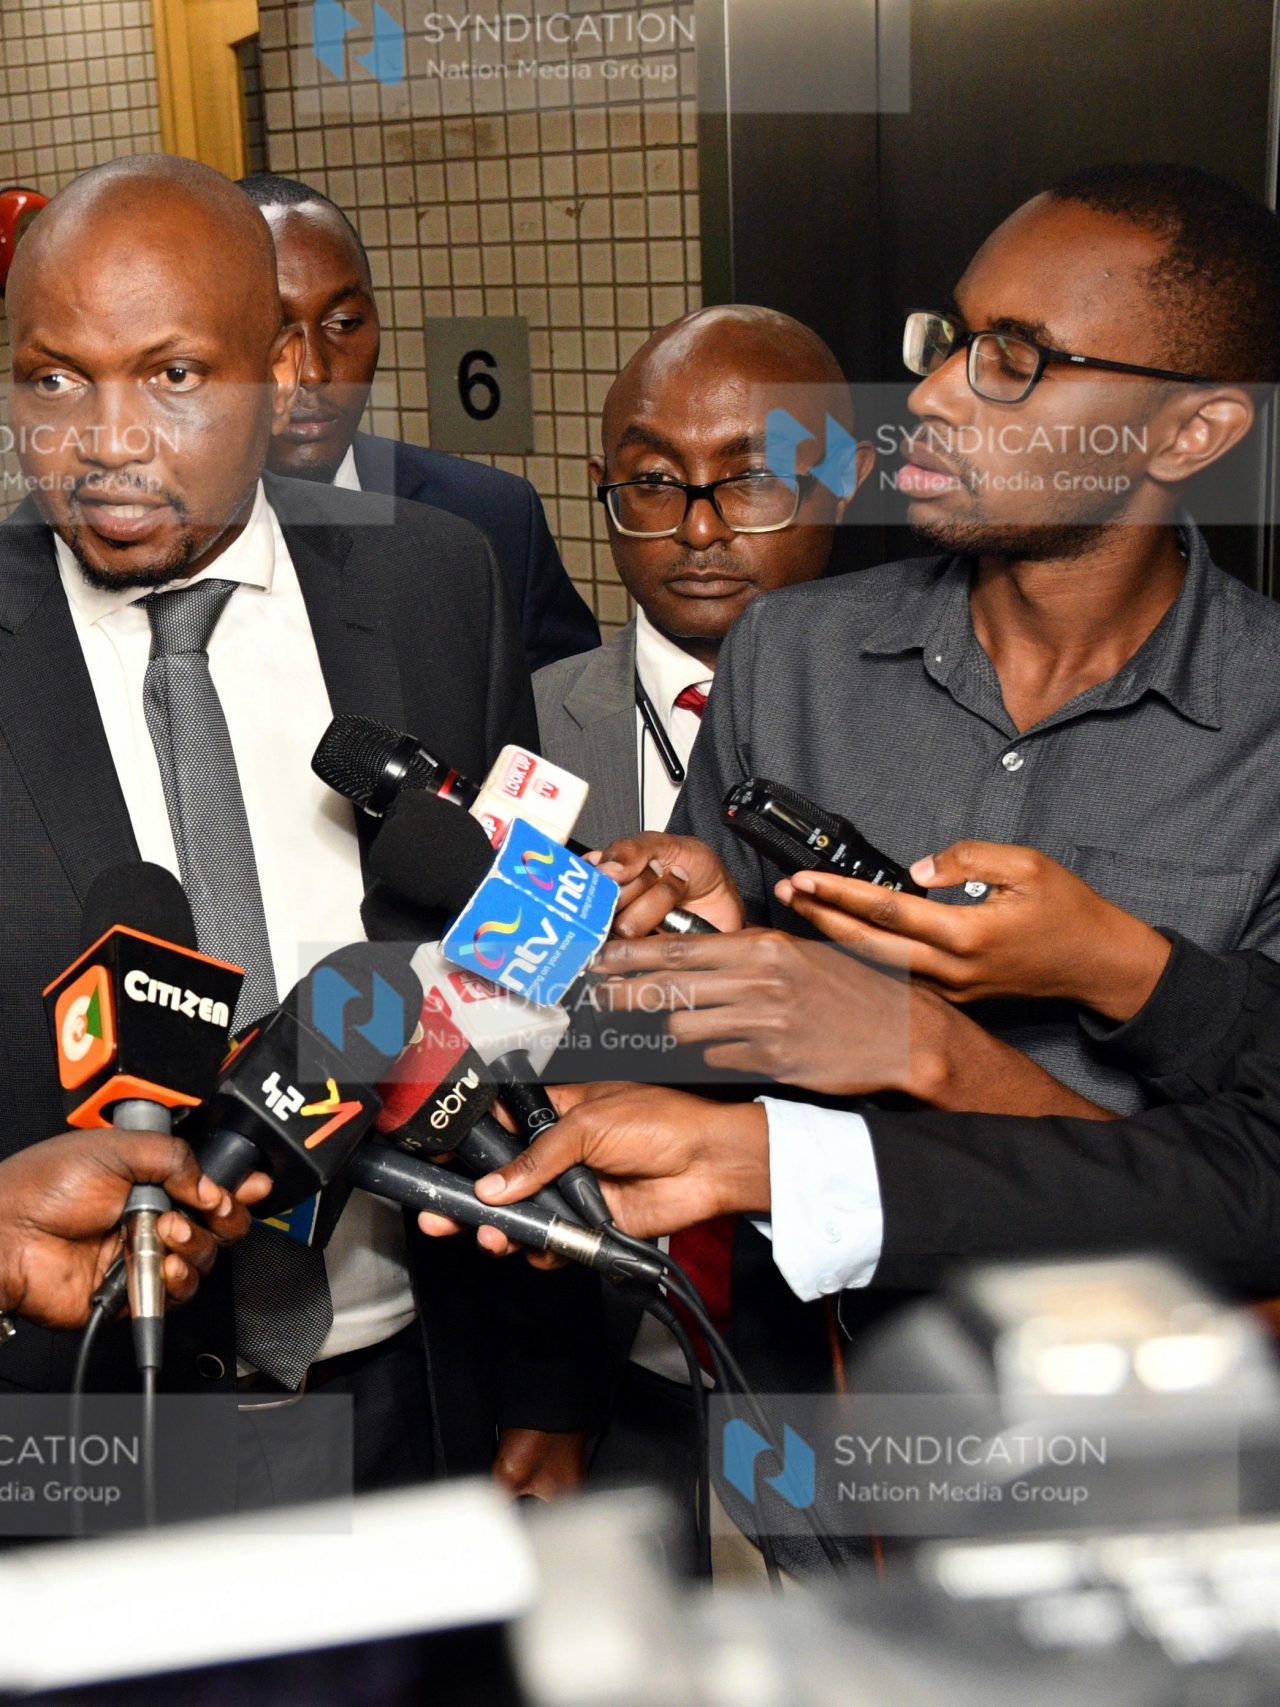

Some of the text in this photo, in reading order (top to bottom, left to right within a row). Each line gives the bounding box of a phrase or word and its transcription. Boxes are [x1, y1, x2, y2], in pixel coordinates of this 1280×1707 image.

[458, 350, 500, 420] 6
[503, 754, 533, 797] LOOK UP
[538, 780, 556, 797] TV
[554, 856, 589, 914] ntv
[498, 916, 559, 991] ntv
[546, 949, 563, 967] your
[557, 930, 576, 951] world
[124, 969, 229, 1028] CITIZEN
